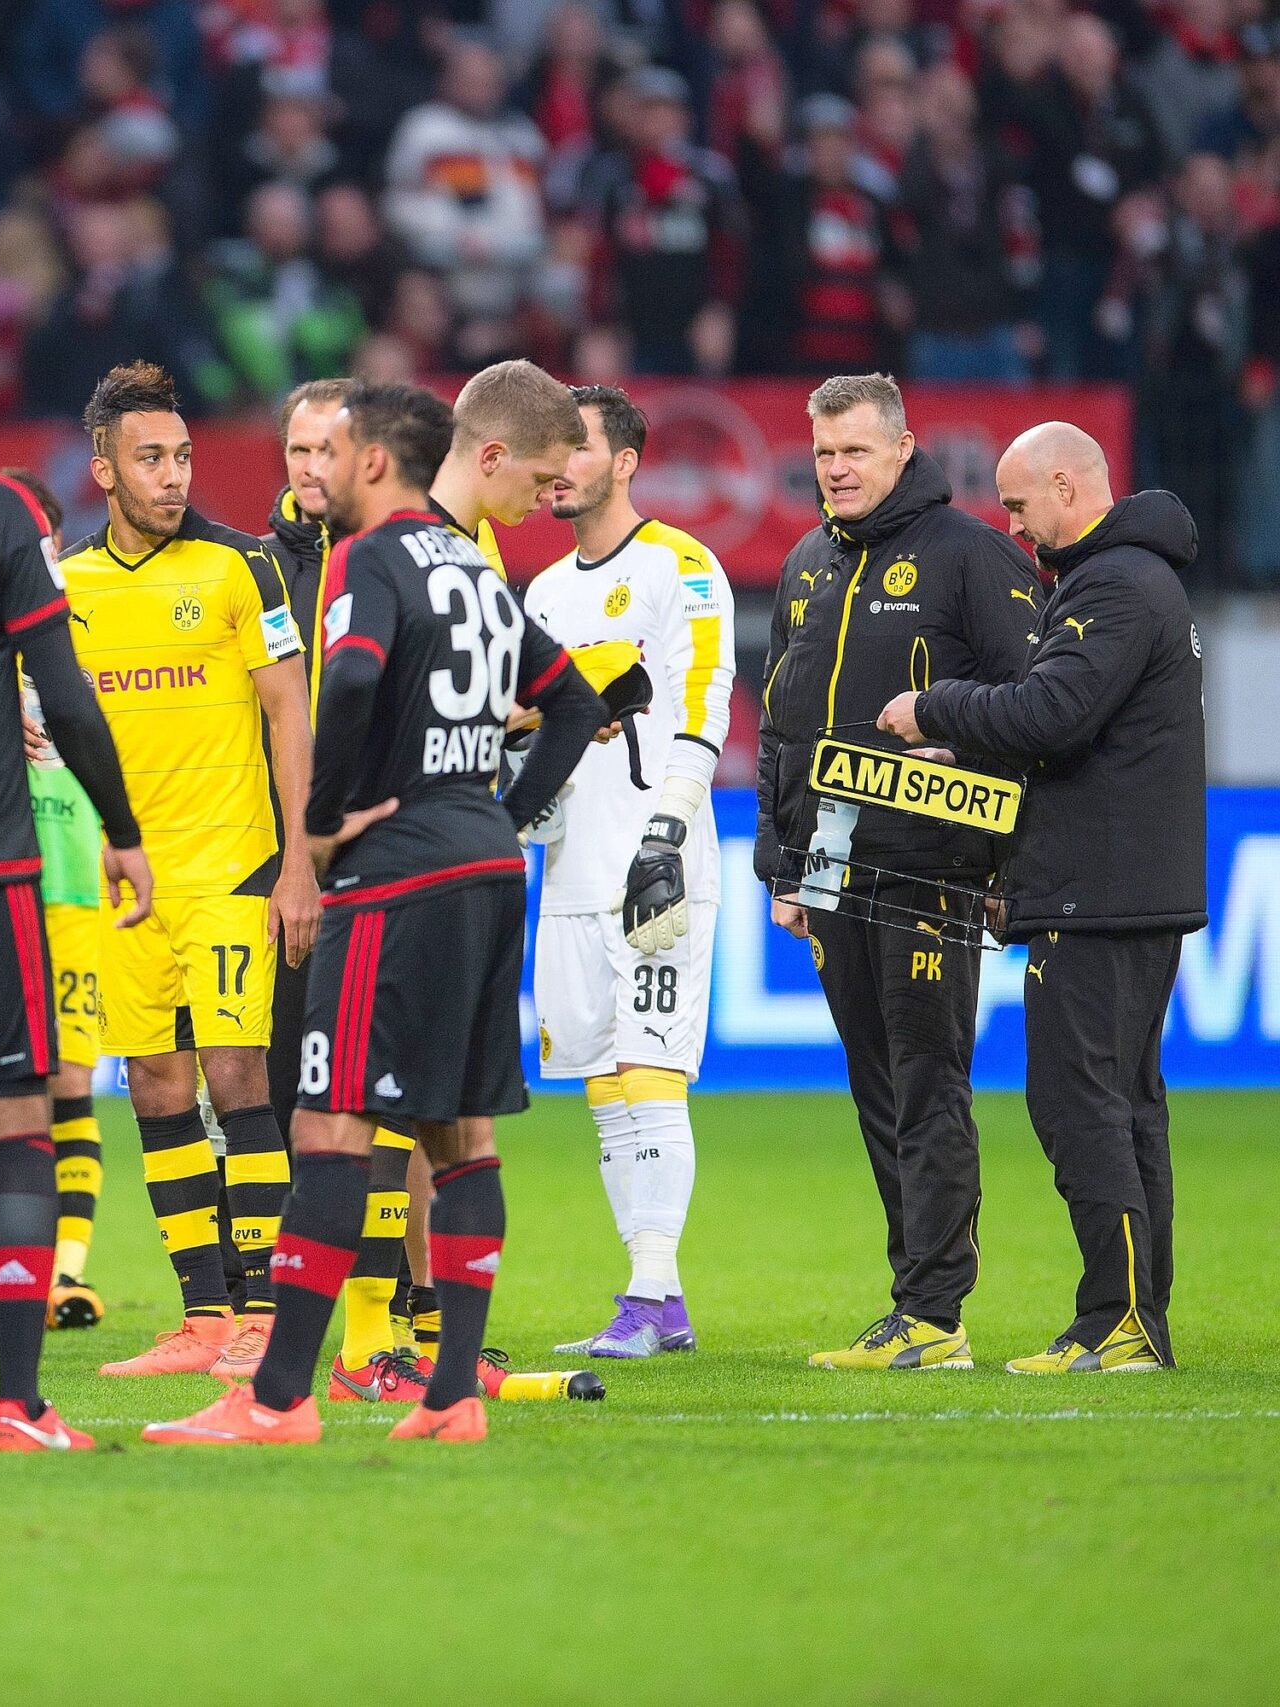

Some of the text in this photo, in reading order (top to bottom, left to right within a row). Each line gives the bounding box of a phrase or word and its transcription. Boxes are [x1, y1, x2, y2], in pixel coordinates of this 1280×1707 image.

[889, 566, 913, 586] BVB
[174, 599, 201, 620] BVB
[684, 601, 720, 613] Hermes
[790, 598, 809, 628] PK
[883, 602, 920, 613] EVONIK
[181, 619, 191, 628] 09
[268, 634, 297, 651] Hermes
[427, 564, 525, 723] 38
[99, 664, 207, 693] EVONIK
[822, 751, 1011, 822] AM SPORT
[211, 944, 251, 997] 17
[911, 951, 943, 981] PK
[59, 970, 97, 1015] 23
[633, 964, 679, 1014] 38
[297, 1030, 330, 1096] 8
[235, 1228, 262, 1240] BVB
